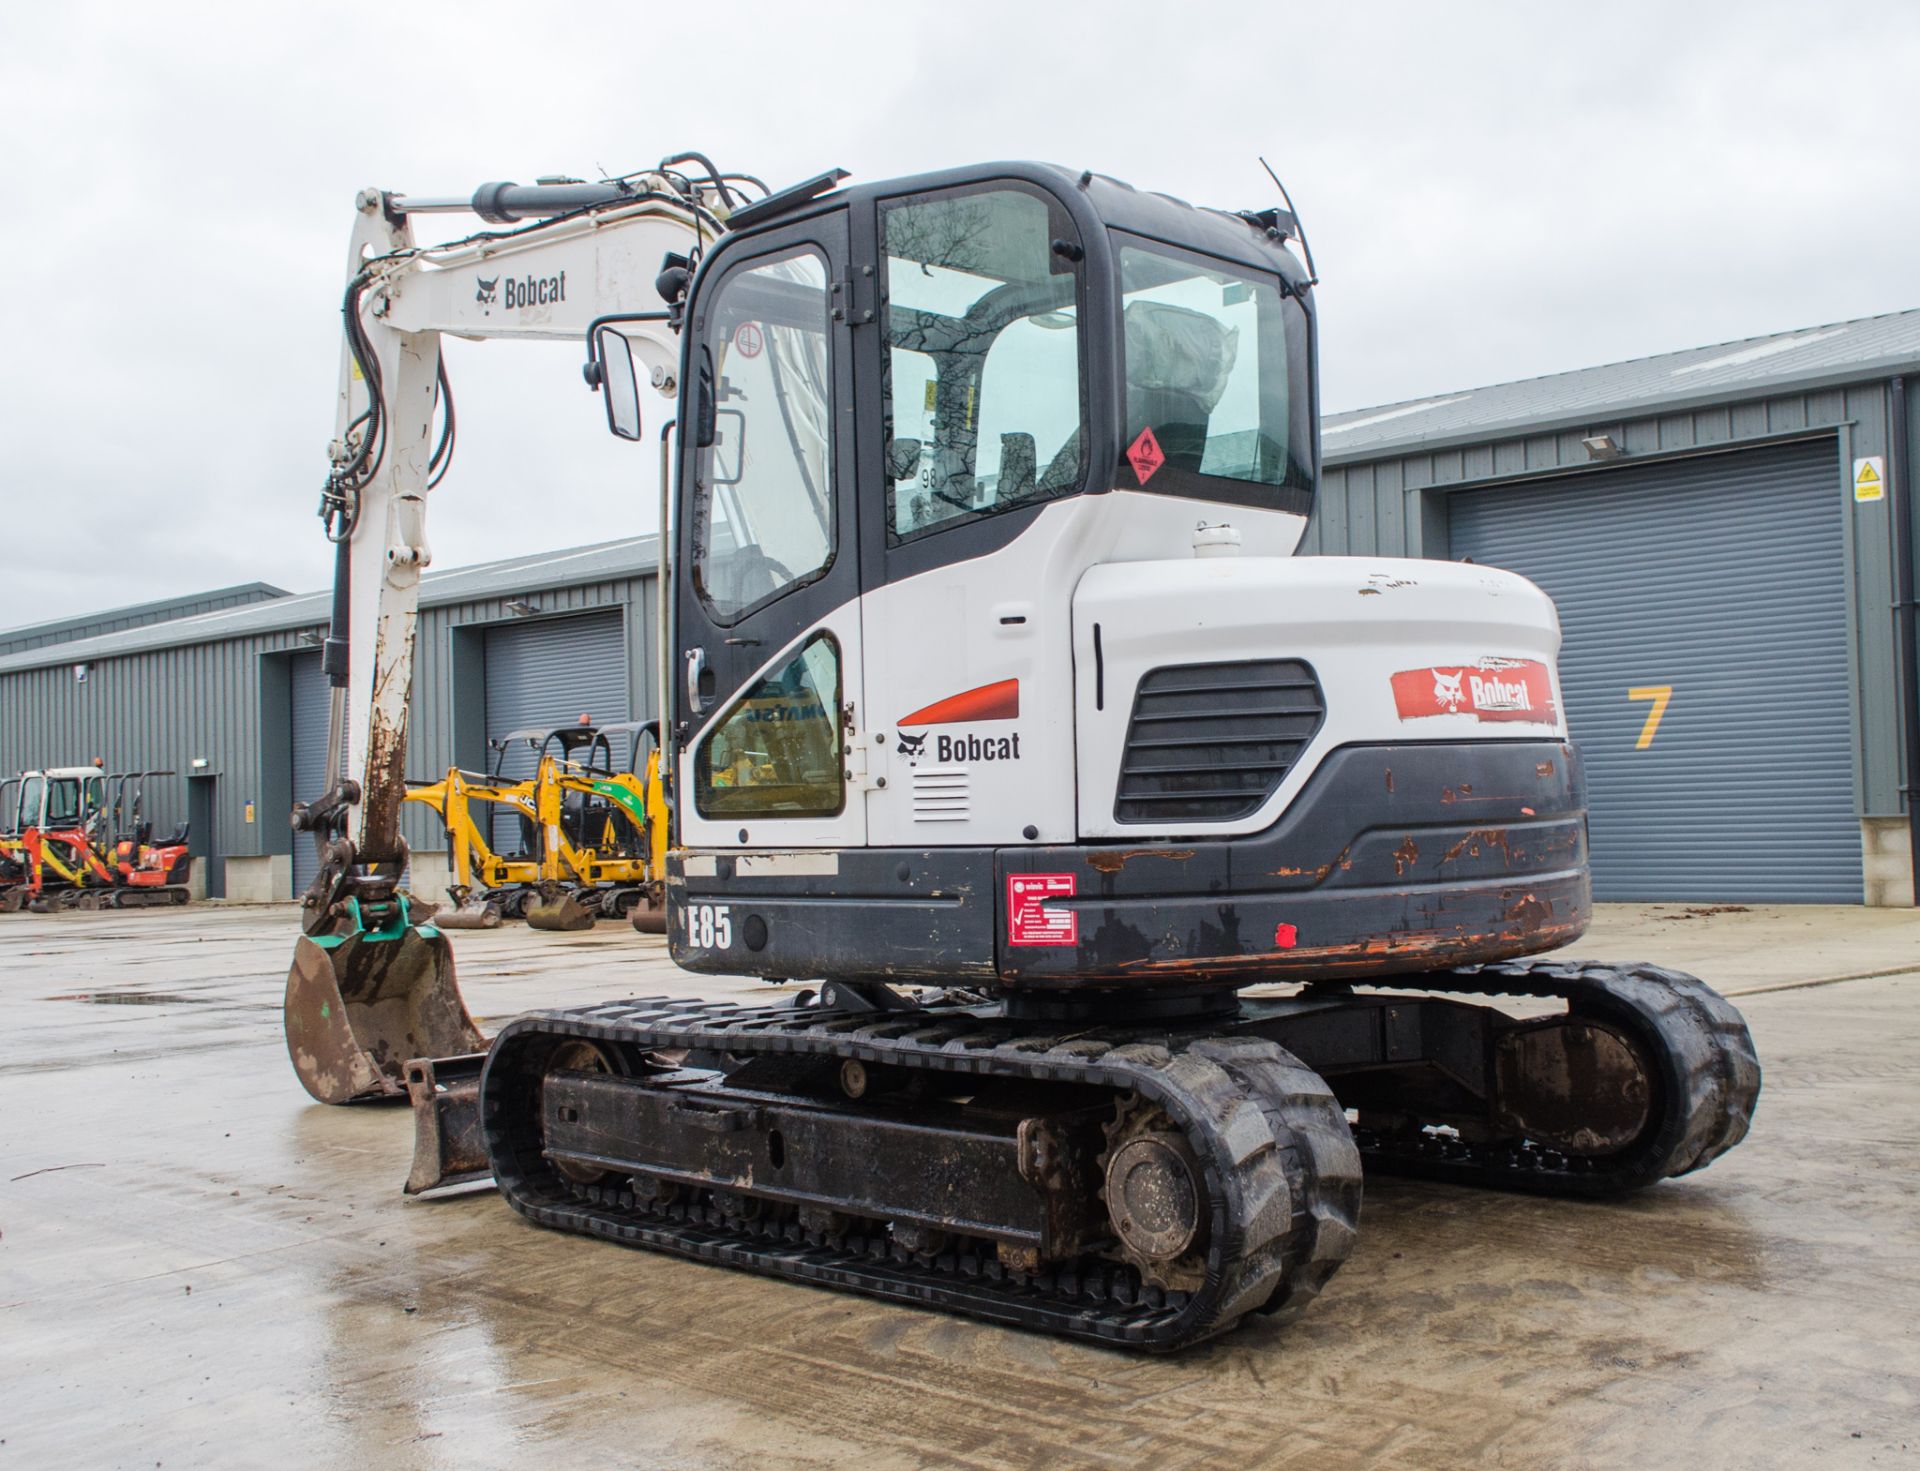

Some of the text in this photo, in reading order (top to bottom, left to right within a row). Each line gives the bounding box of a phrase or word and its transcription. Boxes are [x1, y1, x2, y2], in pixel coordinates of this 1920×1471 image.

[505, 271, 566, 310] Bobcat
[1469, 676, 1532, 711] Bobcat
[1628, 686, 1673, 750] 7
[938, 732, 1020, 762] Bobcat
[687, 905, 732, 950] E85
